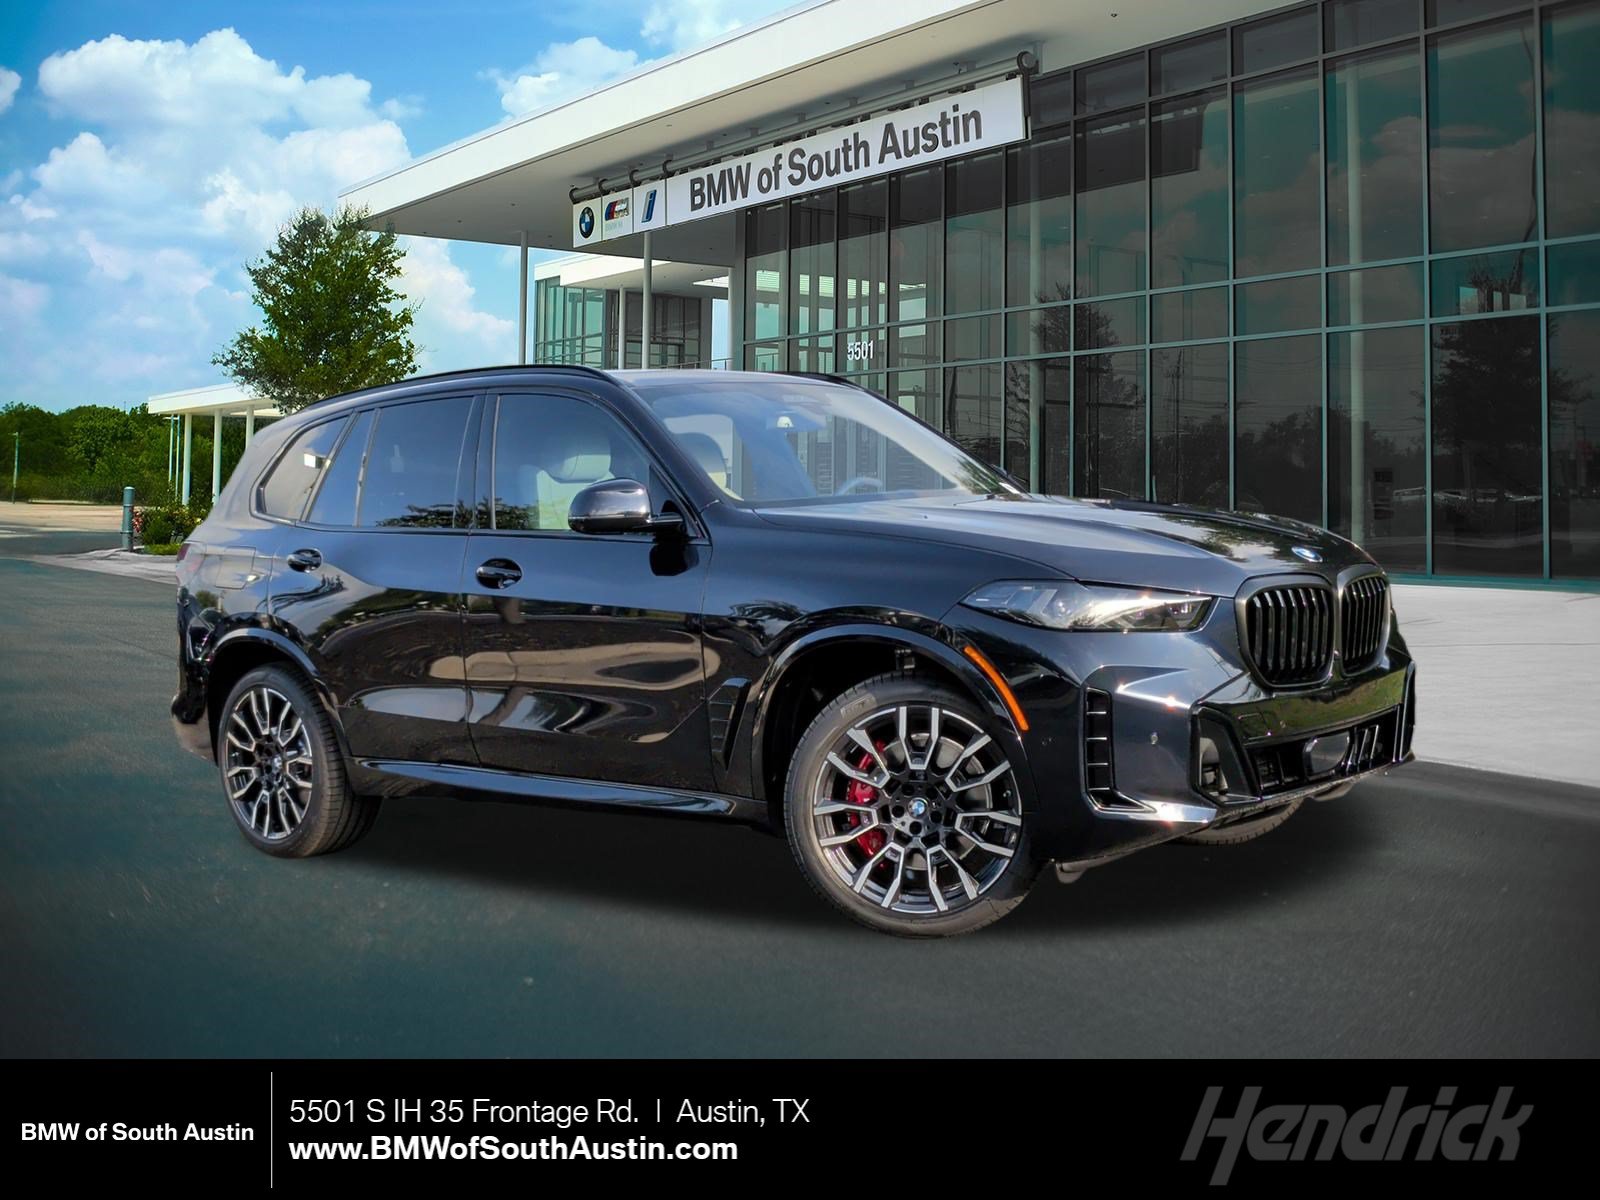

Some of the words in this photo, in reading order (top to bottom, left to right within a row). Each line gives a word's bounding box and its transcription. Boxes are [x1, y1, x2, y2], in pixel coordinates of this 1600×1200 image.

[690, 162, 751, 212] BMW
[757, 153, 782, 194] of
[789, 131, 870, 186] South
[878, 103, 982, 164] Austin
[847, 340, 874, 360] 5501
